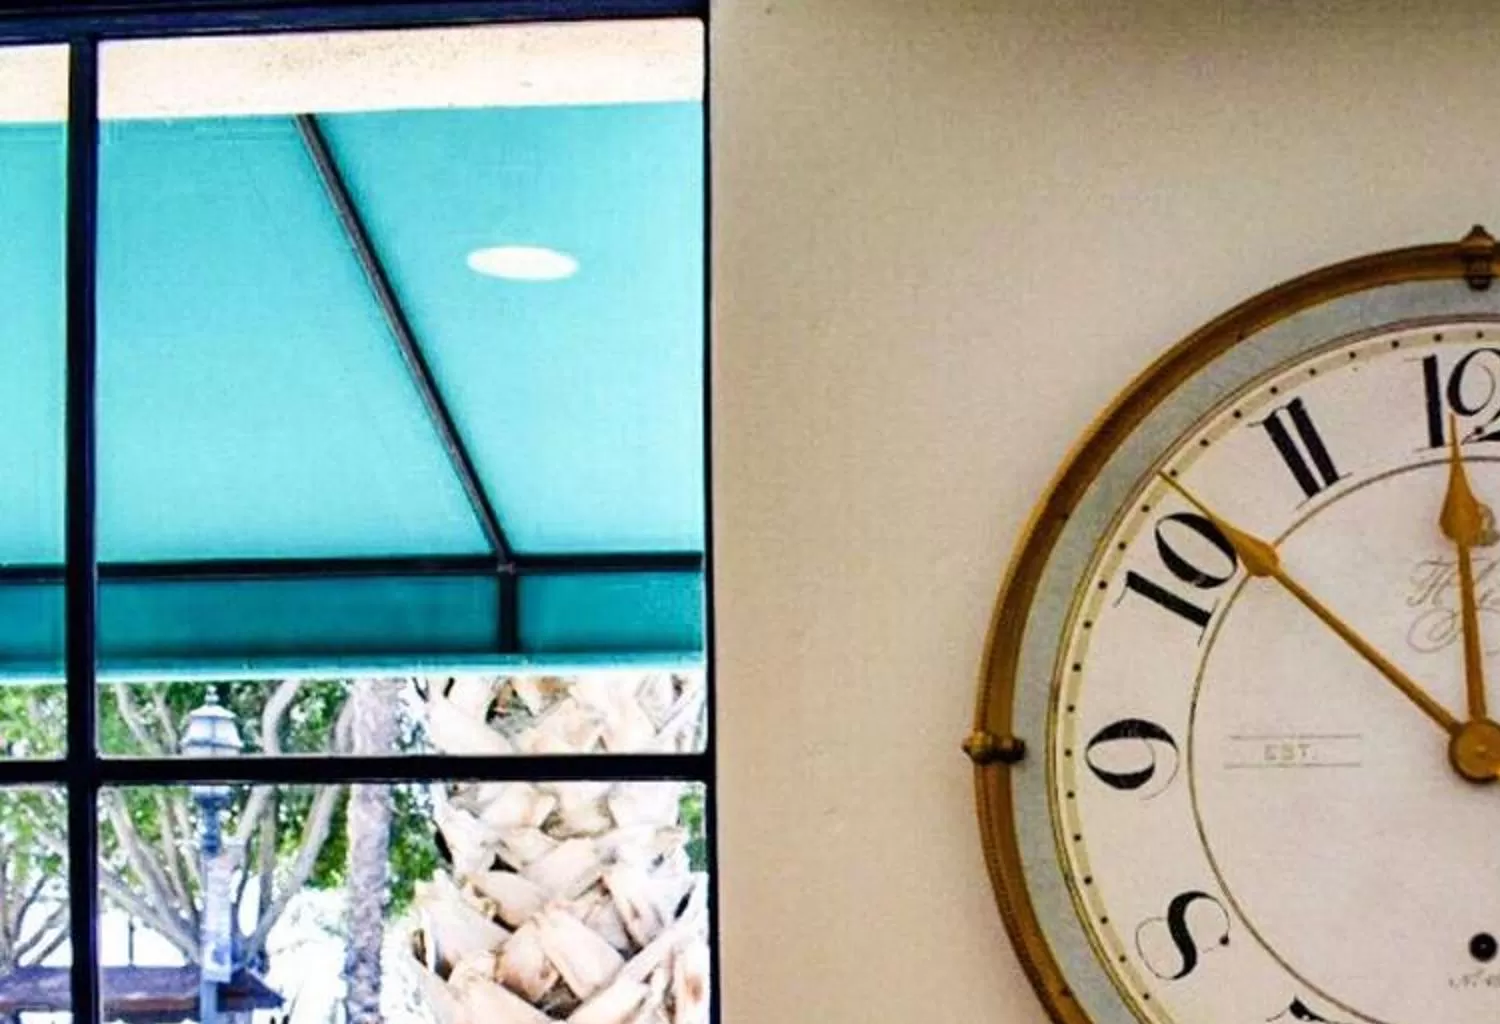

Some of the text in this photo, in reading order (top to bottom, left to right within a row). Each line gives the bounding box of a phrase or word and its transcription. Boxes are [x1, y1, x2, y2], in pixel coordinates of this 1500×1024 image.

[1255, 395, 1346, 509] 11
[1112, 510, 1242, 643] 10
[1085, 717, 1180, 801] 9
[1134, 888, 1231, 981] 8
